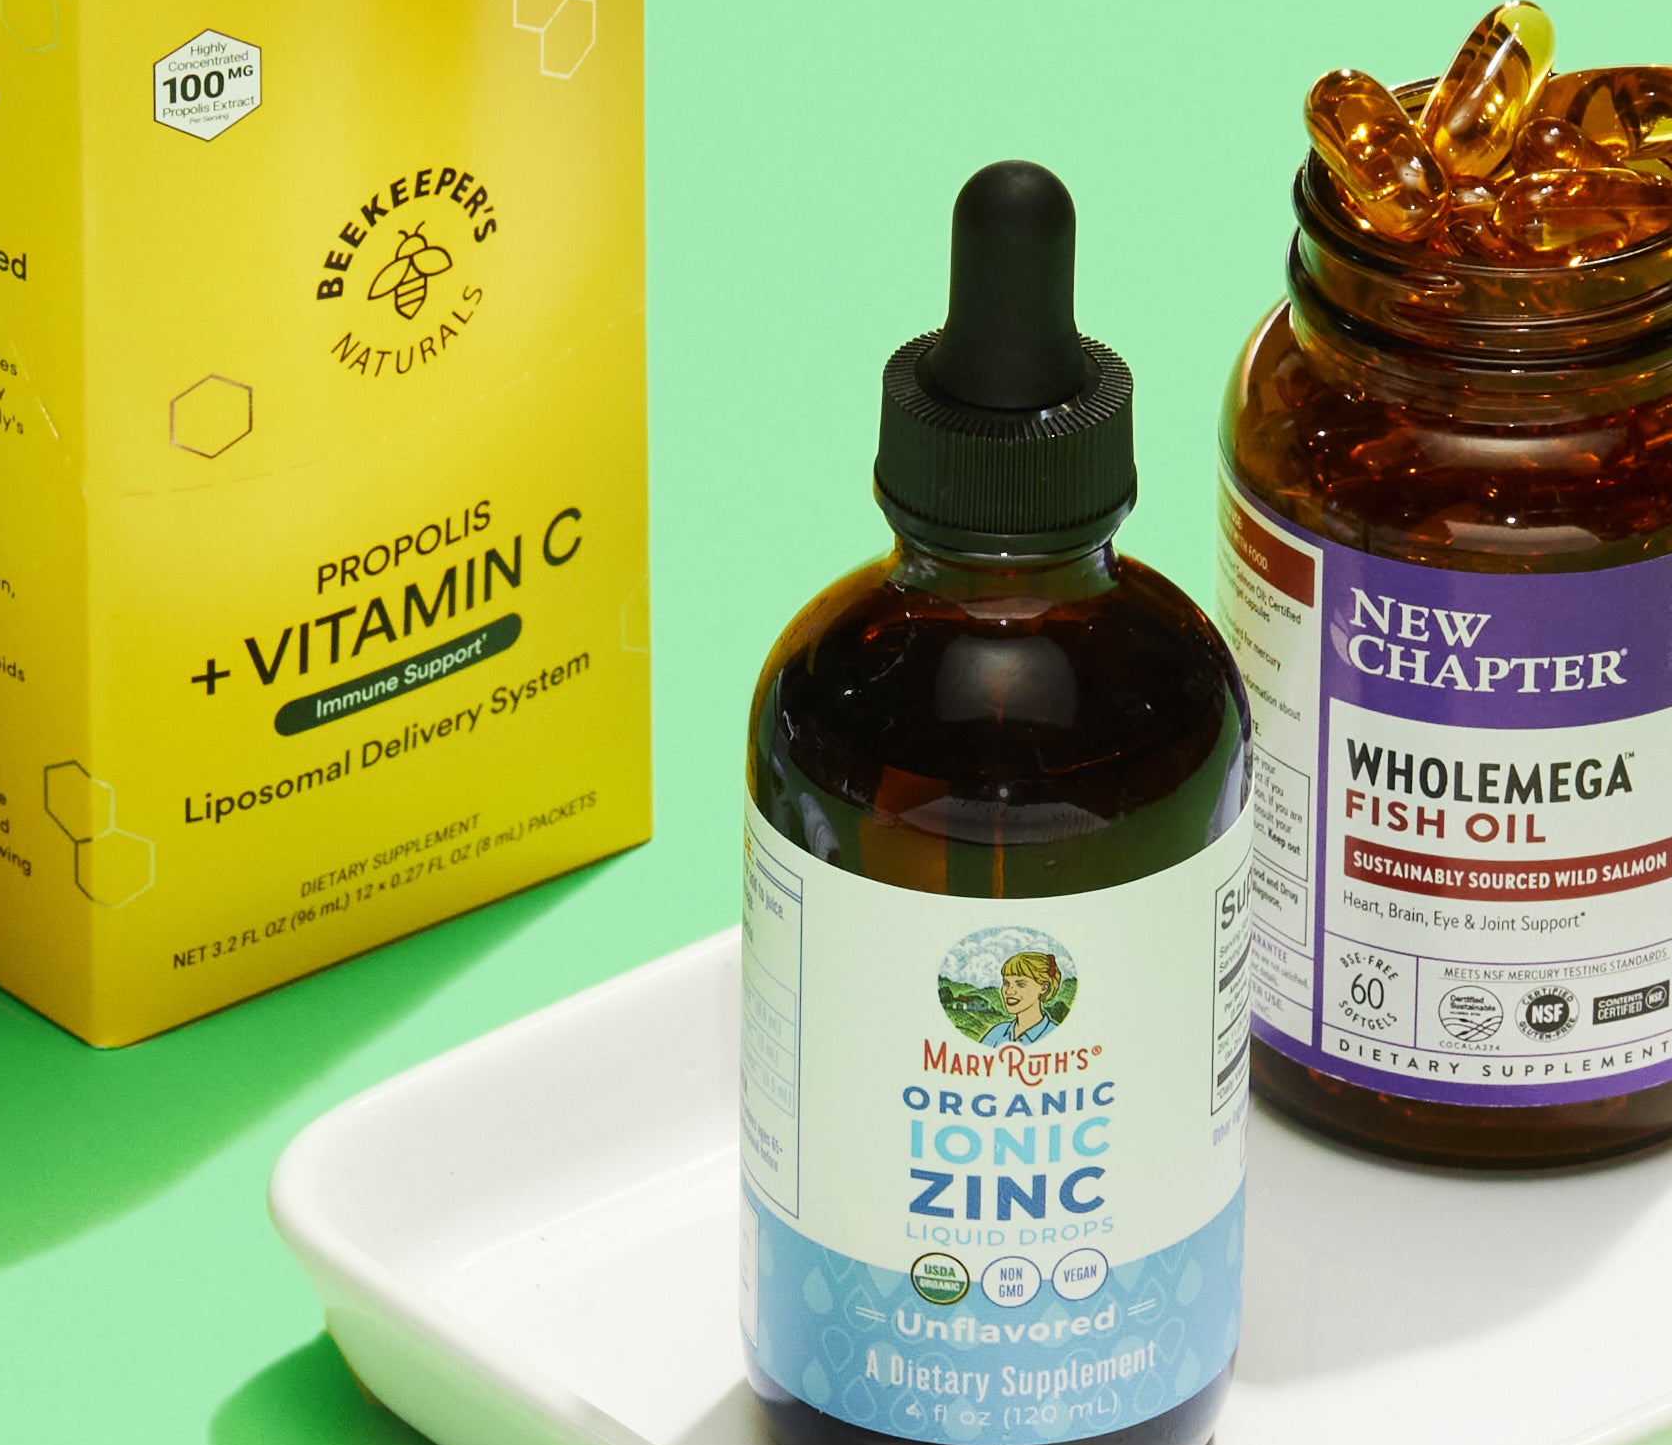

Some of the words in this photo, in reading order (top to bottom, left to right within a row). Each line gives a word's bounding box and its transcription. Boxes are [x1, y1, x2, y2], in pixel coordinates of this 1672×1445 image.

[168, 50, 248, 72] Concentrated
[190, 42, 227, 57] Highly
[163, 70, 224, 104] 100
[228, 65, 253, 80] MG
[162, 103, 209, 118] Propolis
[213, 96, 254, 112] Extract
[316, 167, 497, 301] BEEKEEPER'S
[331, 285, 483, 377] NATURALS
[316, 499, 491, 595] PROPOLIS
[191, 658, 231, 695] +
[244, 534, 522, 687] VITAMIN
[542, 507, 583, 567] C
[1349, 587, 1491, 648] NEW
[315, 674, 399, 719] Immune
[184, 749, 351, 824] Liposomal
[360, 703, 482, 770] Delivery
[490, 651, 590, 714] System
[1346, 788, 1445, 839] FISH
[1465, 813, 1546, 843] OIL
[299, 858, 369, 899] DIETARY
[371, 811, 482, 871] SUPPLEMENT
[1353, 850, 1464, 887] SUSTAINABLY
[1468, 872, 1550, 890] SOURCED
[1555, 869, 1597, 888] WILD
[1602, 851, 1667, 882] SALMON
[172, 944, 209, 970] NET
[212, 935, 239, 959] 3.2
[240, 928, 262, 947] FL
[264, 916, 288, 938] OZ
[290, 906, 316, 932] (96
[319, 893, 351, 922] mL)
[355, 884, 374, 903] 12
[389, 863, 425, 890] 0.27
[426, 856, 446, 877] FL
[449, 843, 474, 867] OZ
[475, 835, 493, 859] (8
[494, 822, 525, 849] mL)
[527, 790, 598, 835] PACKETS
[1343, 890, 1384, 917] Heart,
[1388, 903, 1428, 928] Brain,
[1434, 911, 1459, 931] Eye
[1464, 915, 1475, 930] &
[1479, 915, 1516, 932] Joint
[1340, 952, 1399, 981] BSE-FREE
[1444, 967, 1480, 979] MEETS
[1484, 970, 1504, 980] NSF
[1508, 967, 1559, 981] MERCURY
[1563, 963, 1607, 977] TESTING
[1609, 947, 1668, 970] STANDARDS
[1351, 973, 1384, 1010] 60
[1449, 994, 1485, 1006] Certified
[1522, 987, 1574, 1006] CERTIFIED
[1598, 992, 1643, 1007] CONTENTS
[1648, 991, 1665, 1004] NSF
[1339, 1000, 1398, 1031] SOFTGELS
[1519, 1017, 1577, 1040] GLUTEN-FREE
[1531, 1004, 1564, 1024] NSF
[1598, 1001, 1643, 1021] CERTIFIED
[1339, 1038, 1460, 1075] DIETARY
[1482, 1041, 1669, 1077] SUPPLEMENT
[902, 1081, 1115, 1118] ORGANIC
[910, 1115, 1111, 1166] IONIC
[909, 1166, 1106, 1221] ZINC
[906, 1221, 1005, 1247] LIQUID
[1019, 1216, 1114, 1245] DROPS
[919, 1277, 961, 1293] ORGANIC
[924, 1263, 956, 1279] USDA
[999, 1267, 1023, 1281] NON
[1063, 1263, 1097, 1283] VEGAN
[998, 1283, 1024, 1298] GMO
[896, 1303, 1116, 1344] Unflavored
[865, 1349, 878, 1379] A
[889, 1354, 990, 1403] Dietary
[1001, 1340, 1157, 1401] Supplement
[904, 1401, 921, 1419] 4
[933, 1405, 948, 1423] fl
[960, 1409, 991, 1427] oz
[1003, 1405, 1058, 1429] (120
[1068, 1389, 1120, 1421] mL)
